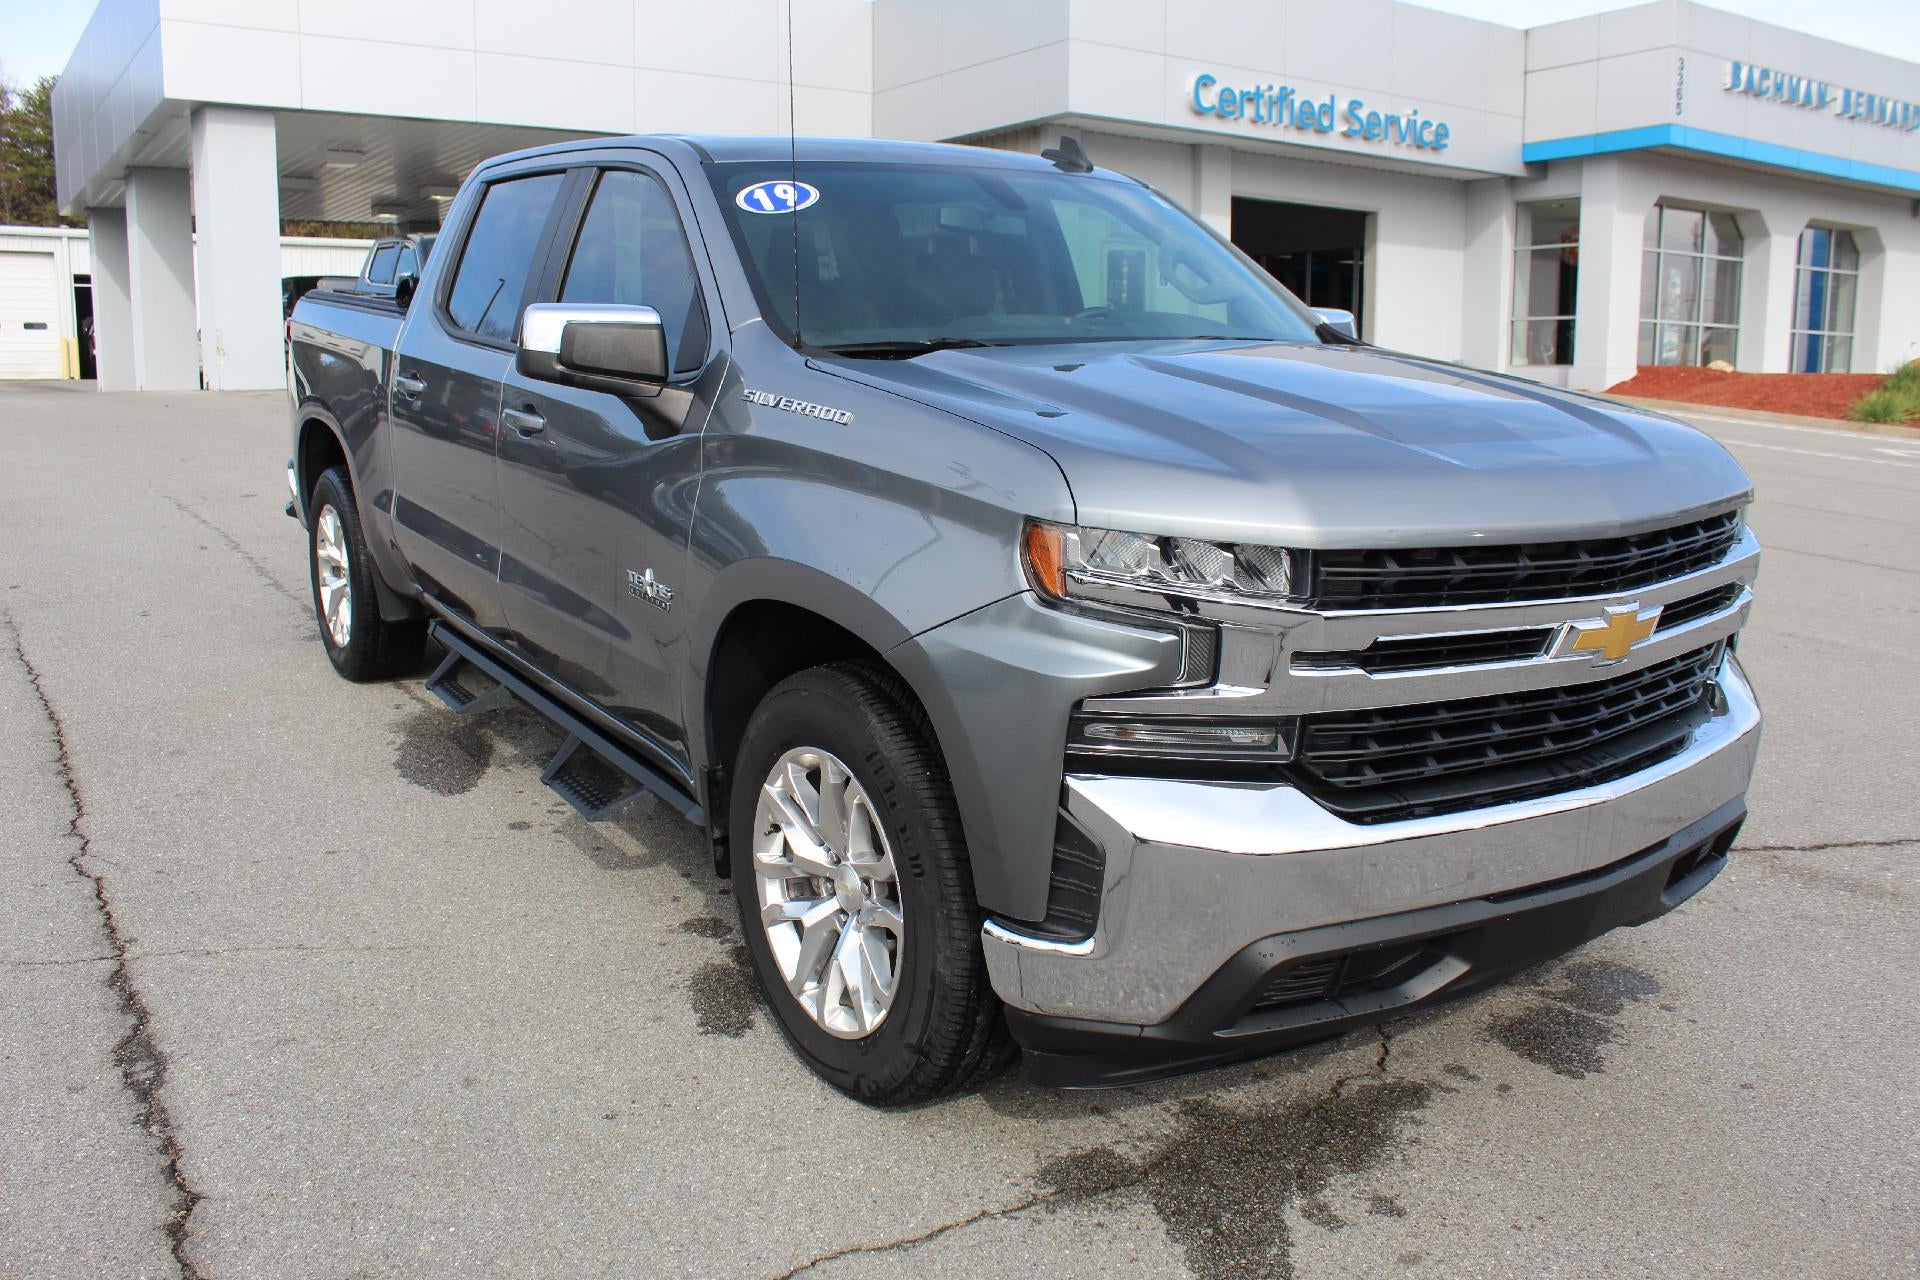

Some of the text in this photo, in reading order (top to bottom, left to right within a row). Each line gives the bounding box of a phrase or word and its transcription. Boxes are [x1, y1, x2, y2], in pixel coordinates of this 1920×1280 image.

[1192, 73, 1451, 150] Certified Service
[753, 183, 798, 211] 19
[742, 388, 853, 425] SILVERADO
